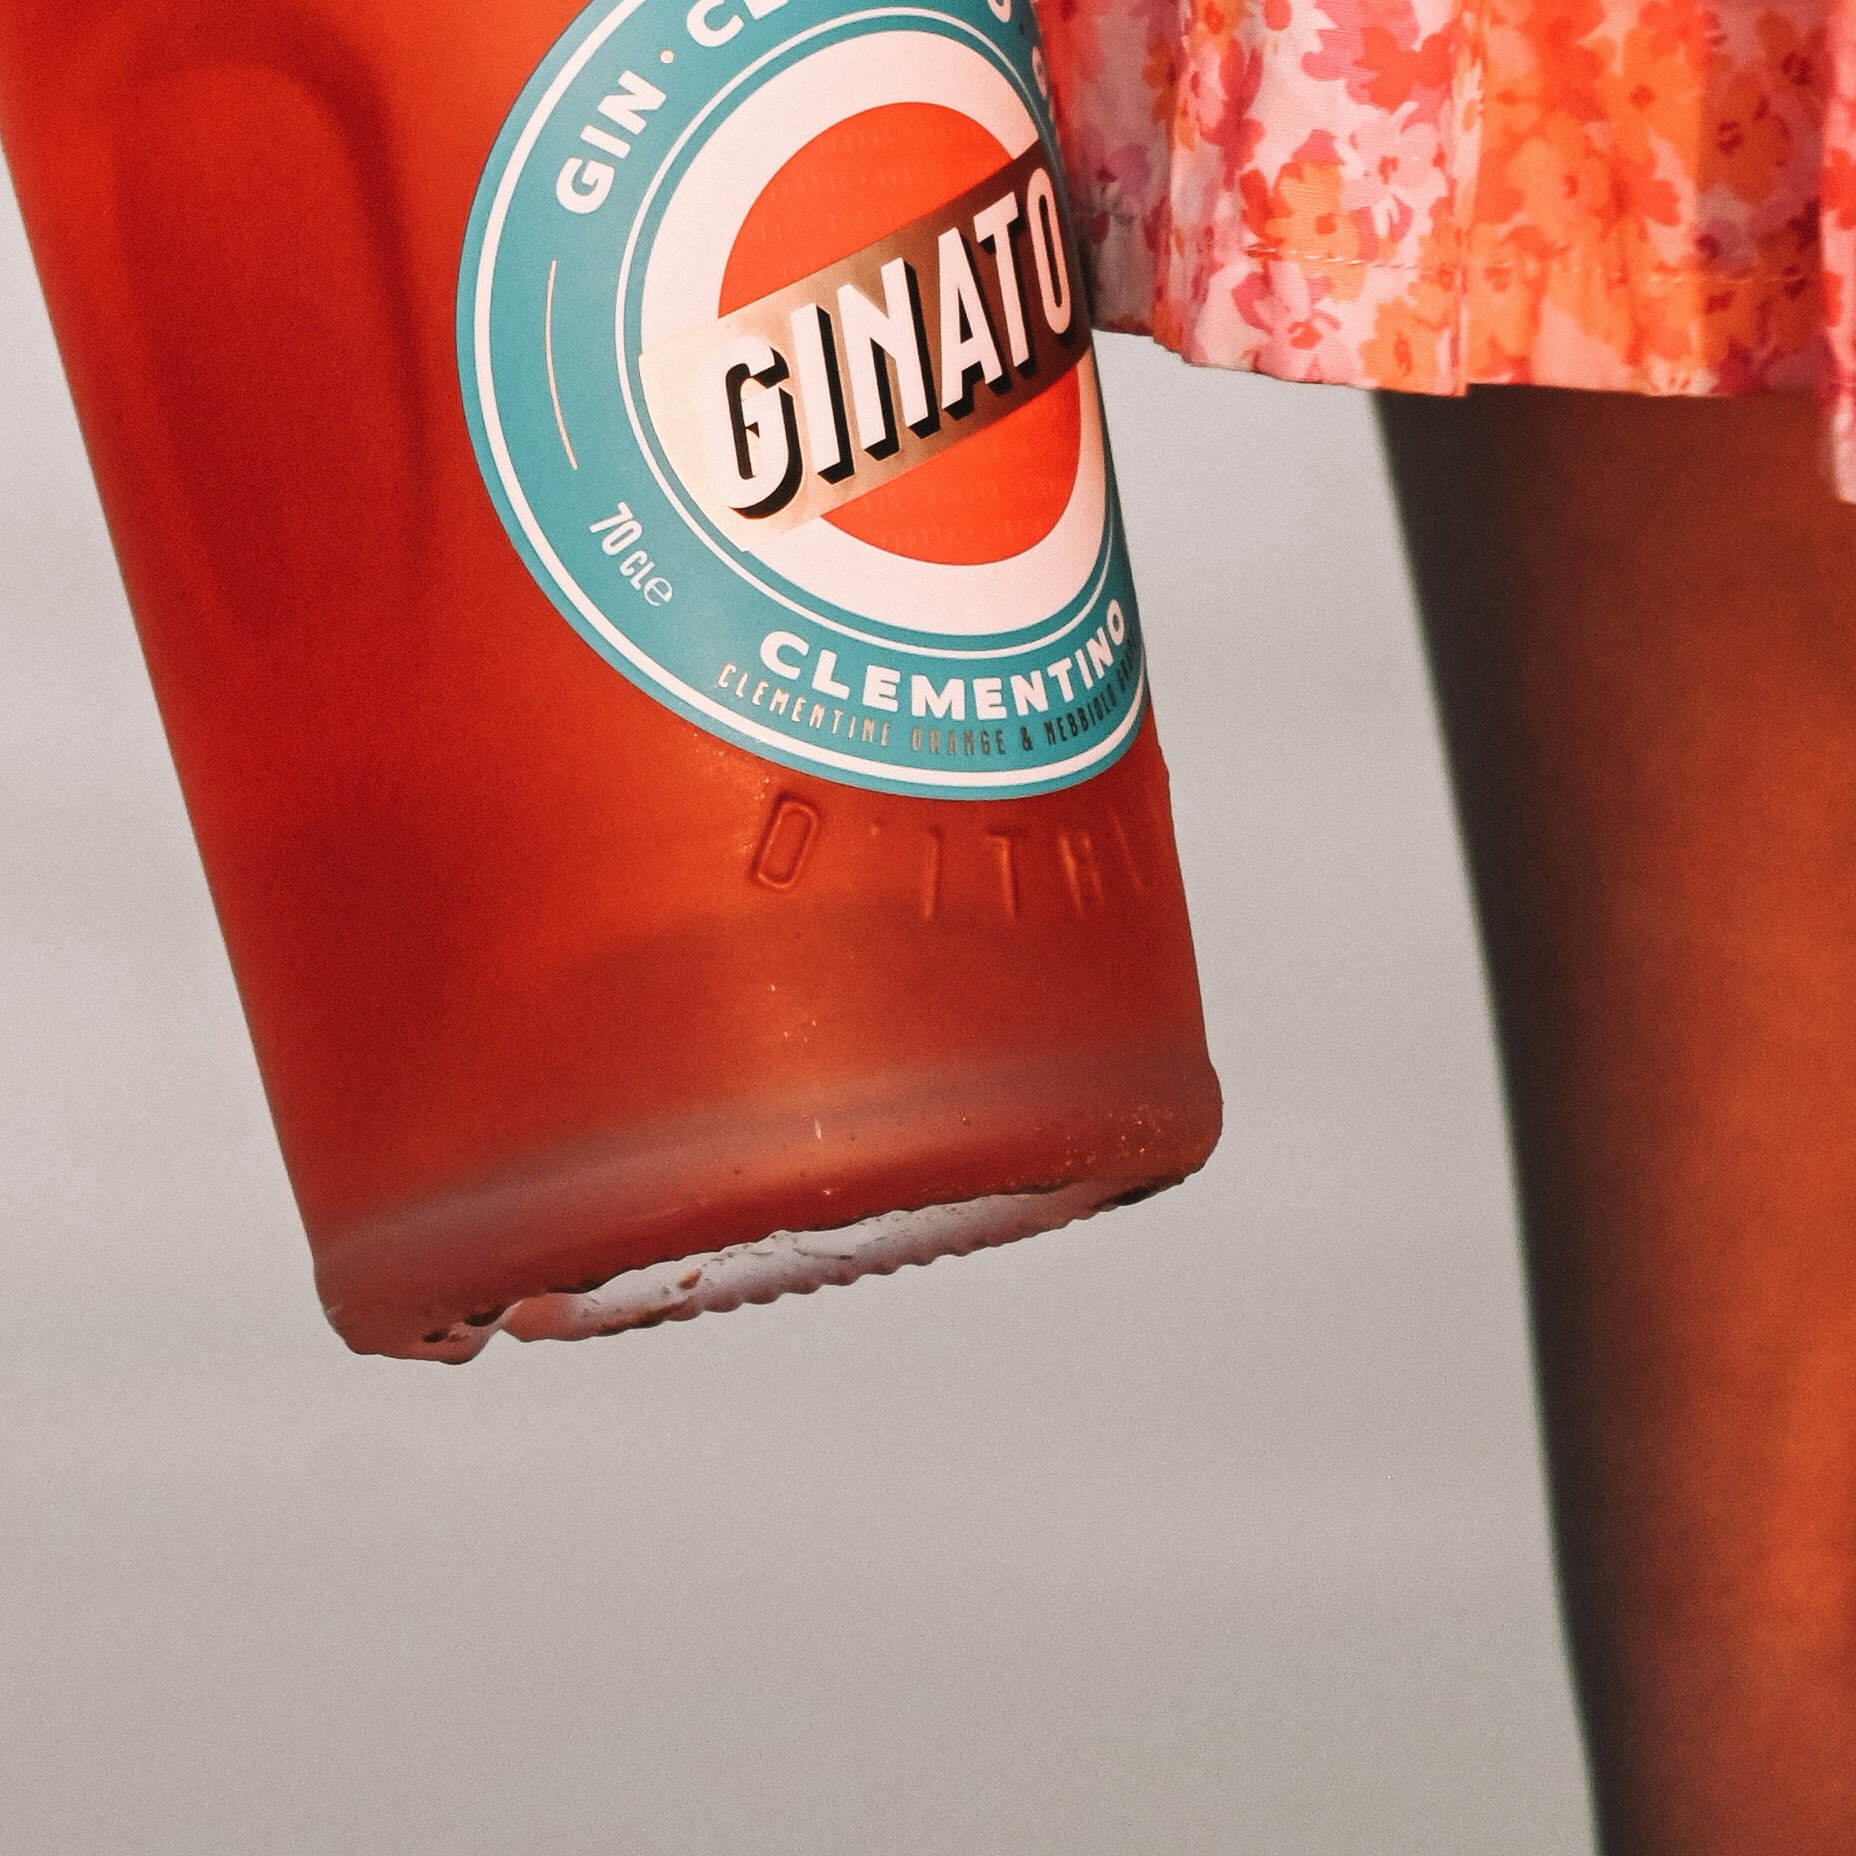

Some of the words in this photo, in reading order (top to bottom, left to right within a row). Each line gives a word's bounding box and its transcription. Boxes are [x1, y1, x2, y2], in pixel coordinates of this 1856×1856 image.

[555, 77, 668, 216] GIN
[706, 165, 1073, 520] GINATO
[589, 500, 643, 556] 70
[717, 661, 891, 747] CLEMENTINE
[1020, 726, 1035, 752] &
[757, 598, 1126, 722] CLEMENTINO
